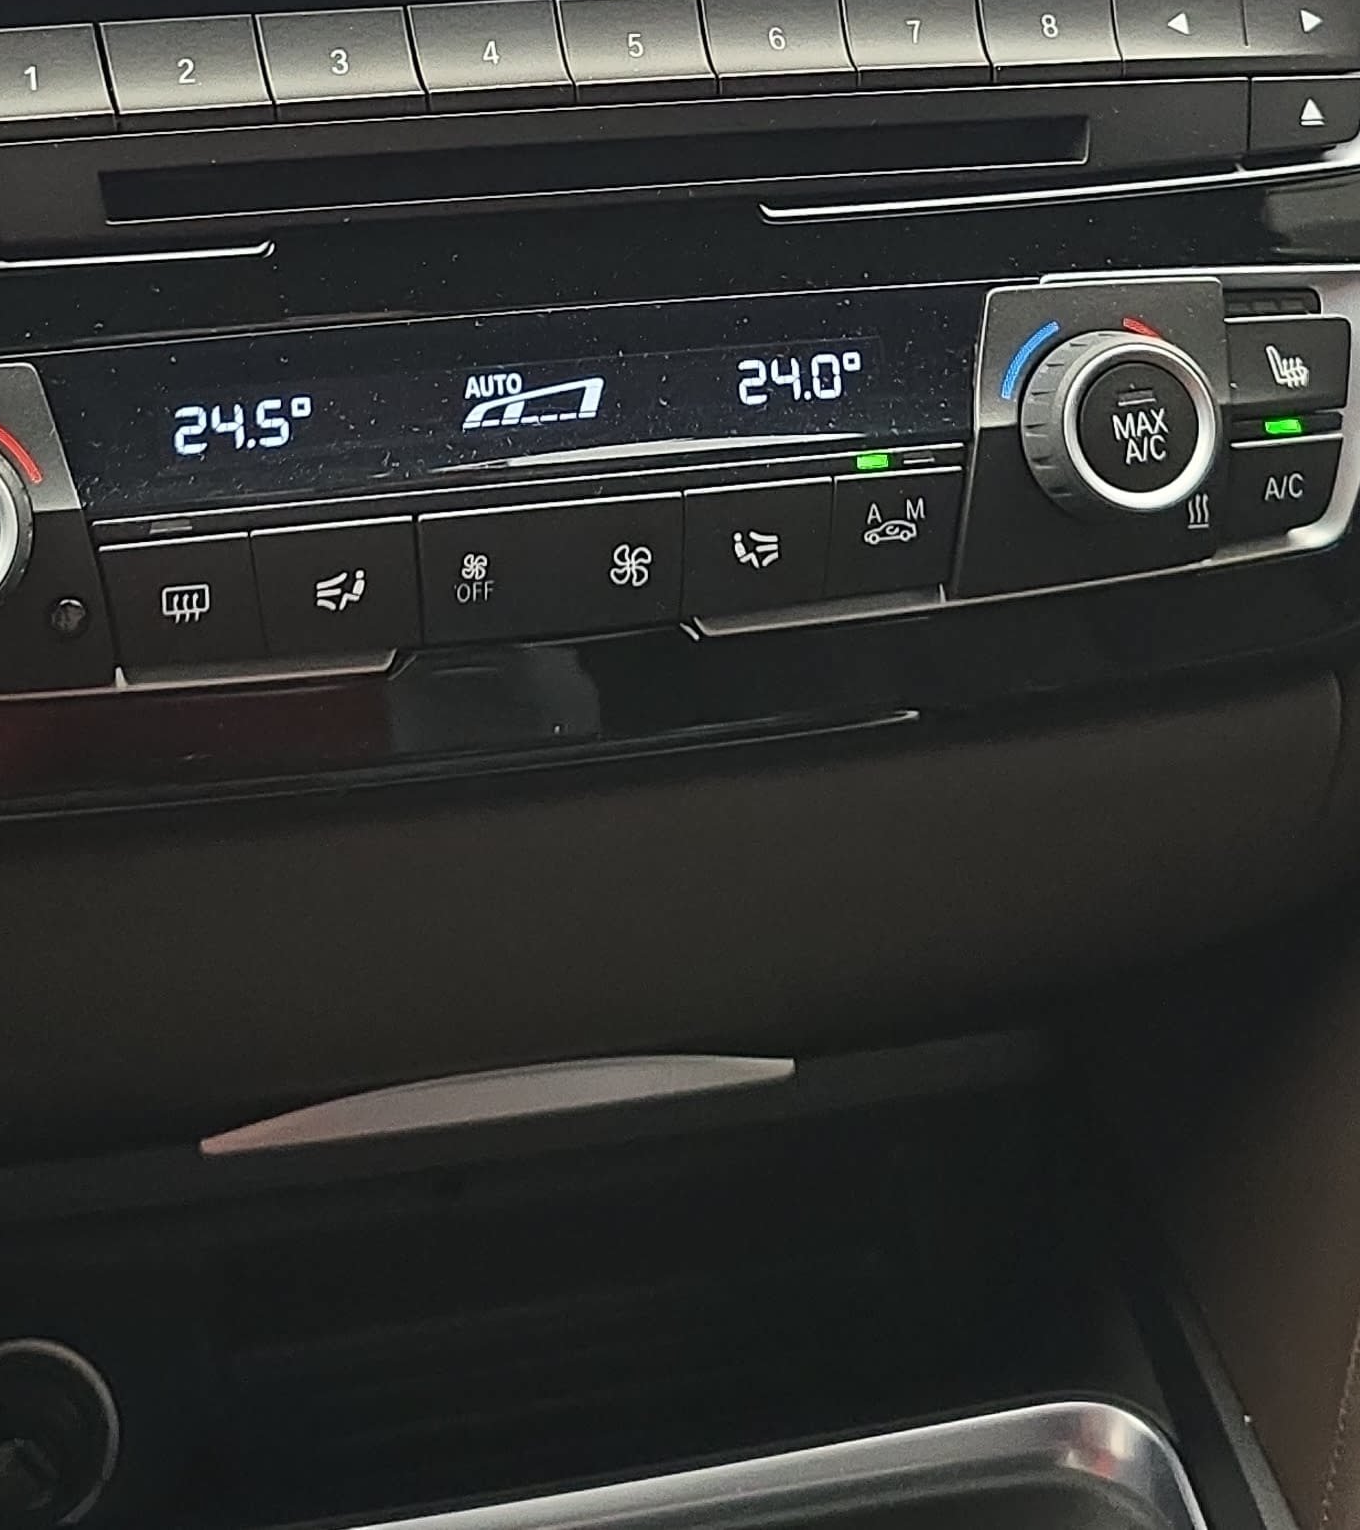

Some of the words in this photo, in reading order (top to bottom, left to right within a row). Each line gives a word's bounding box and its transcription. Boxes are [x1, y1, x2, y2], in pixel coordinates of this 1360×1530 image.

[768, 26, 786, 51] 6
[906, 20, 922, 45] 7
[1041, 14, 1059, 39] 8
[481, 40, 500, 66] 4
[627, 32, 643, 58] 5
[177, 58, 196, 85] 2
[330, 49, 350, 76] 3
[23, 66, 38, 91] 1
[464, 373, 522, 399] AUTO
[1112, 408, 1168, 441] MAX
[1125, 435, 1167, 465] A/C
[1265, 473, 1304, 500] A/C
[867, 504, 882, 524] A
[906, 498, 925, 520] M
[457, 581, 494, 603] OFF
